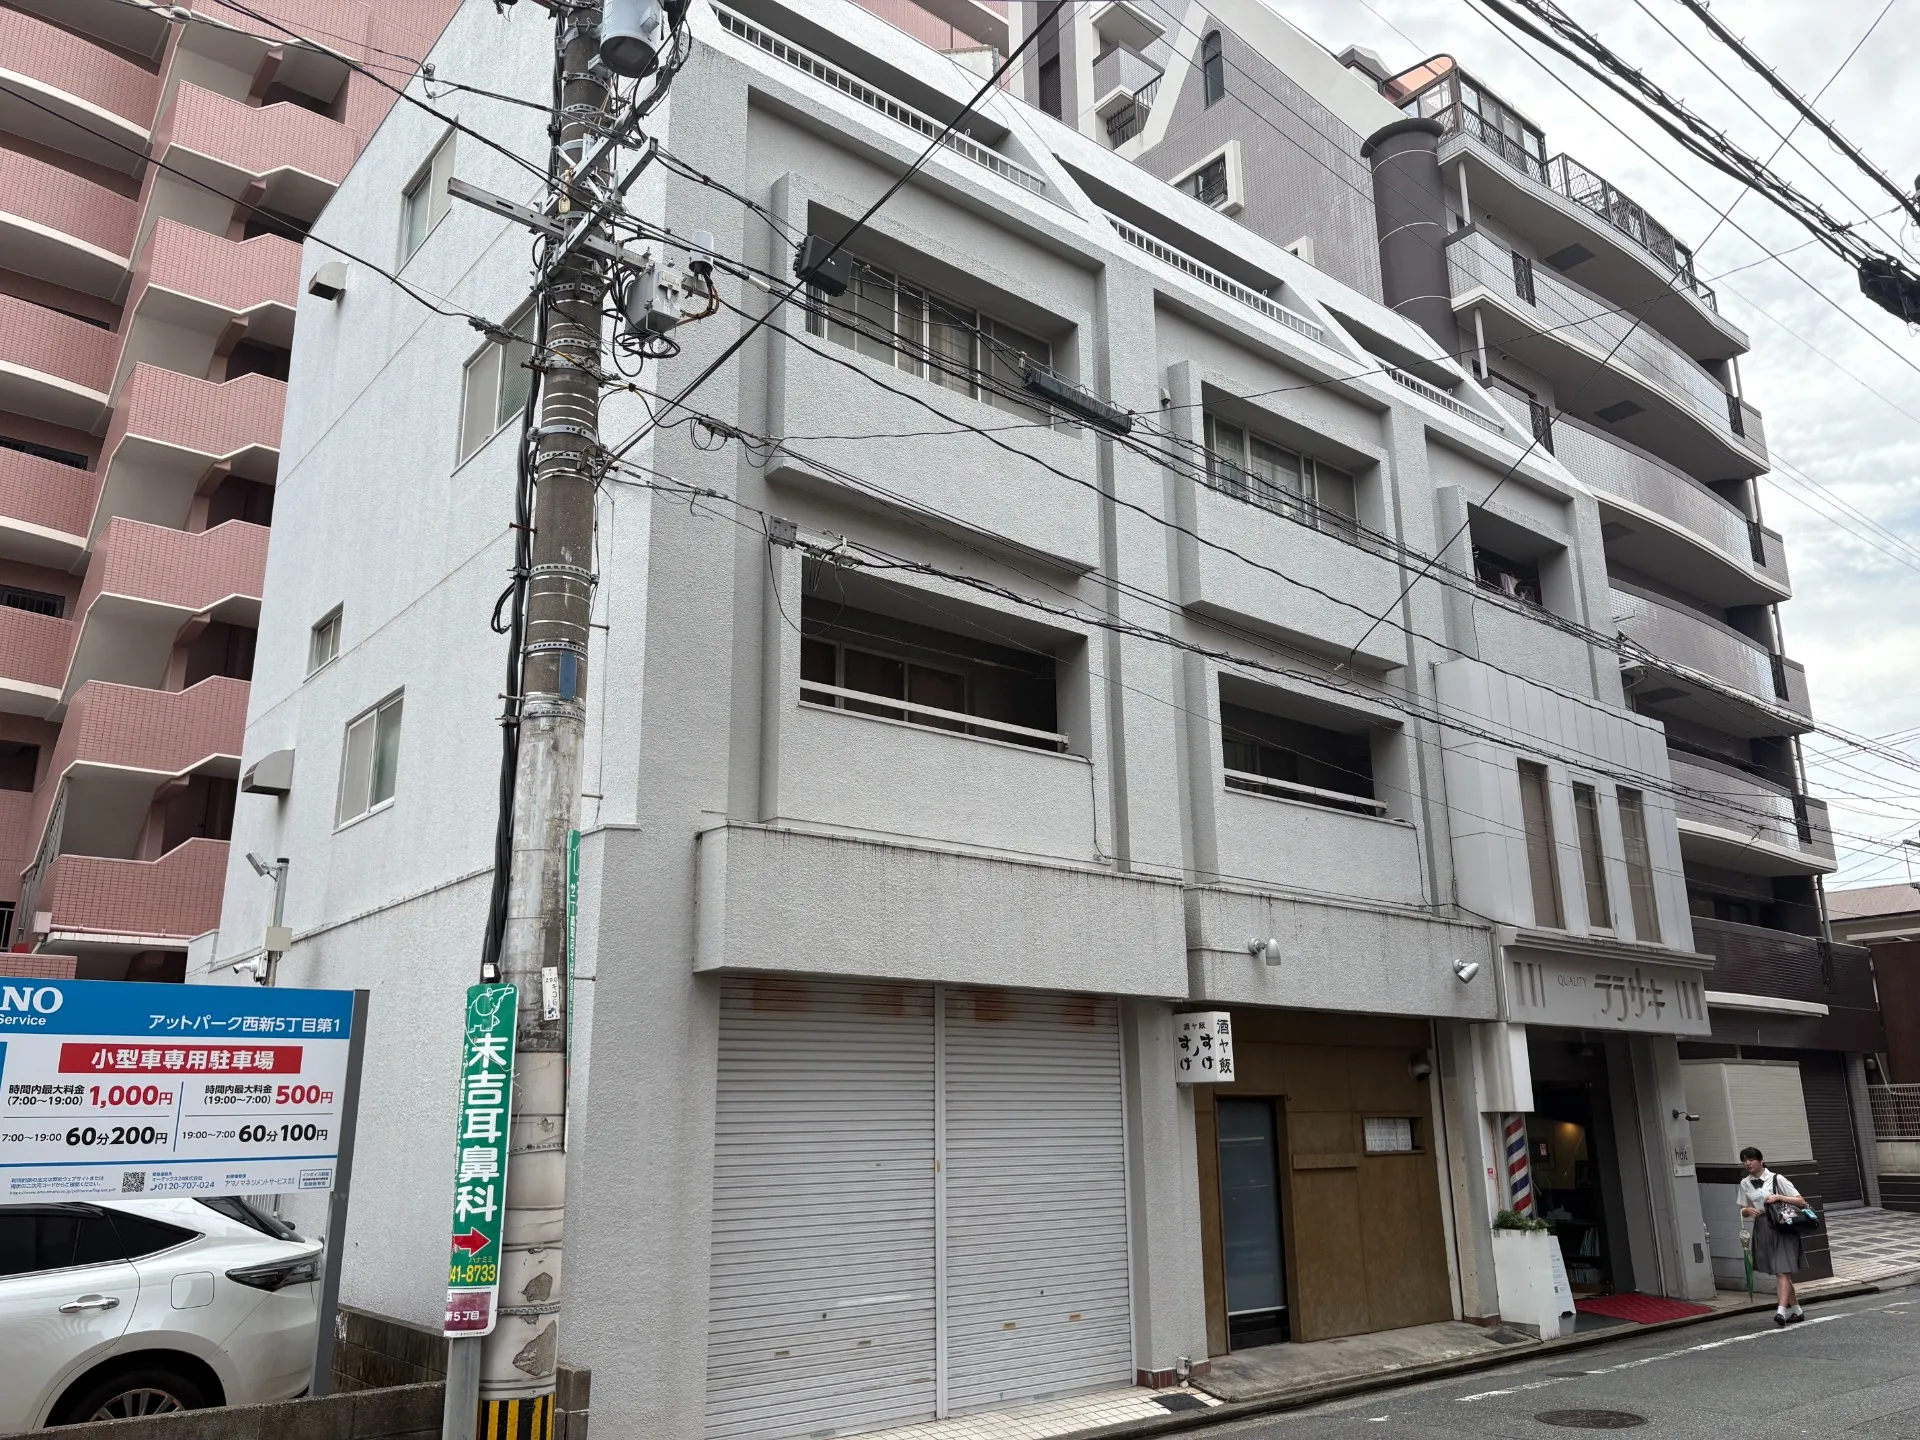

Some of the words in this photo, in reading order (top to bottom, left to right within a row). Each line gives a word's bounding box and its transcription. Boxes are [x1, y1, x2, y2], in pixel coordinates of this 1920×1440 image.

[1557, 974, 1588, 989] QUALITY
[149, 1014, 341, 1033] アットパーク西新5丁目第1
[1217, 1019, 1232, 1074] 酒ヤ飯
[91, 1049, 275, 1070] 小型車専用駐車場
[9, 1084, 86, 1095] 時間内最大料金
[90, 1085, 173, 1109] 1,000円
[205, 1084, 273, 1094] 時間内最大料金
[275, 1084, 334, 1105] 500円
[455, 1033, 509, 1223] 末吉耳鼻科
[157, 1181, 215, 1190] 0120-707-024
